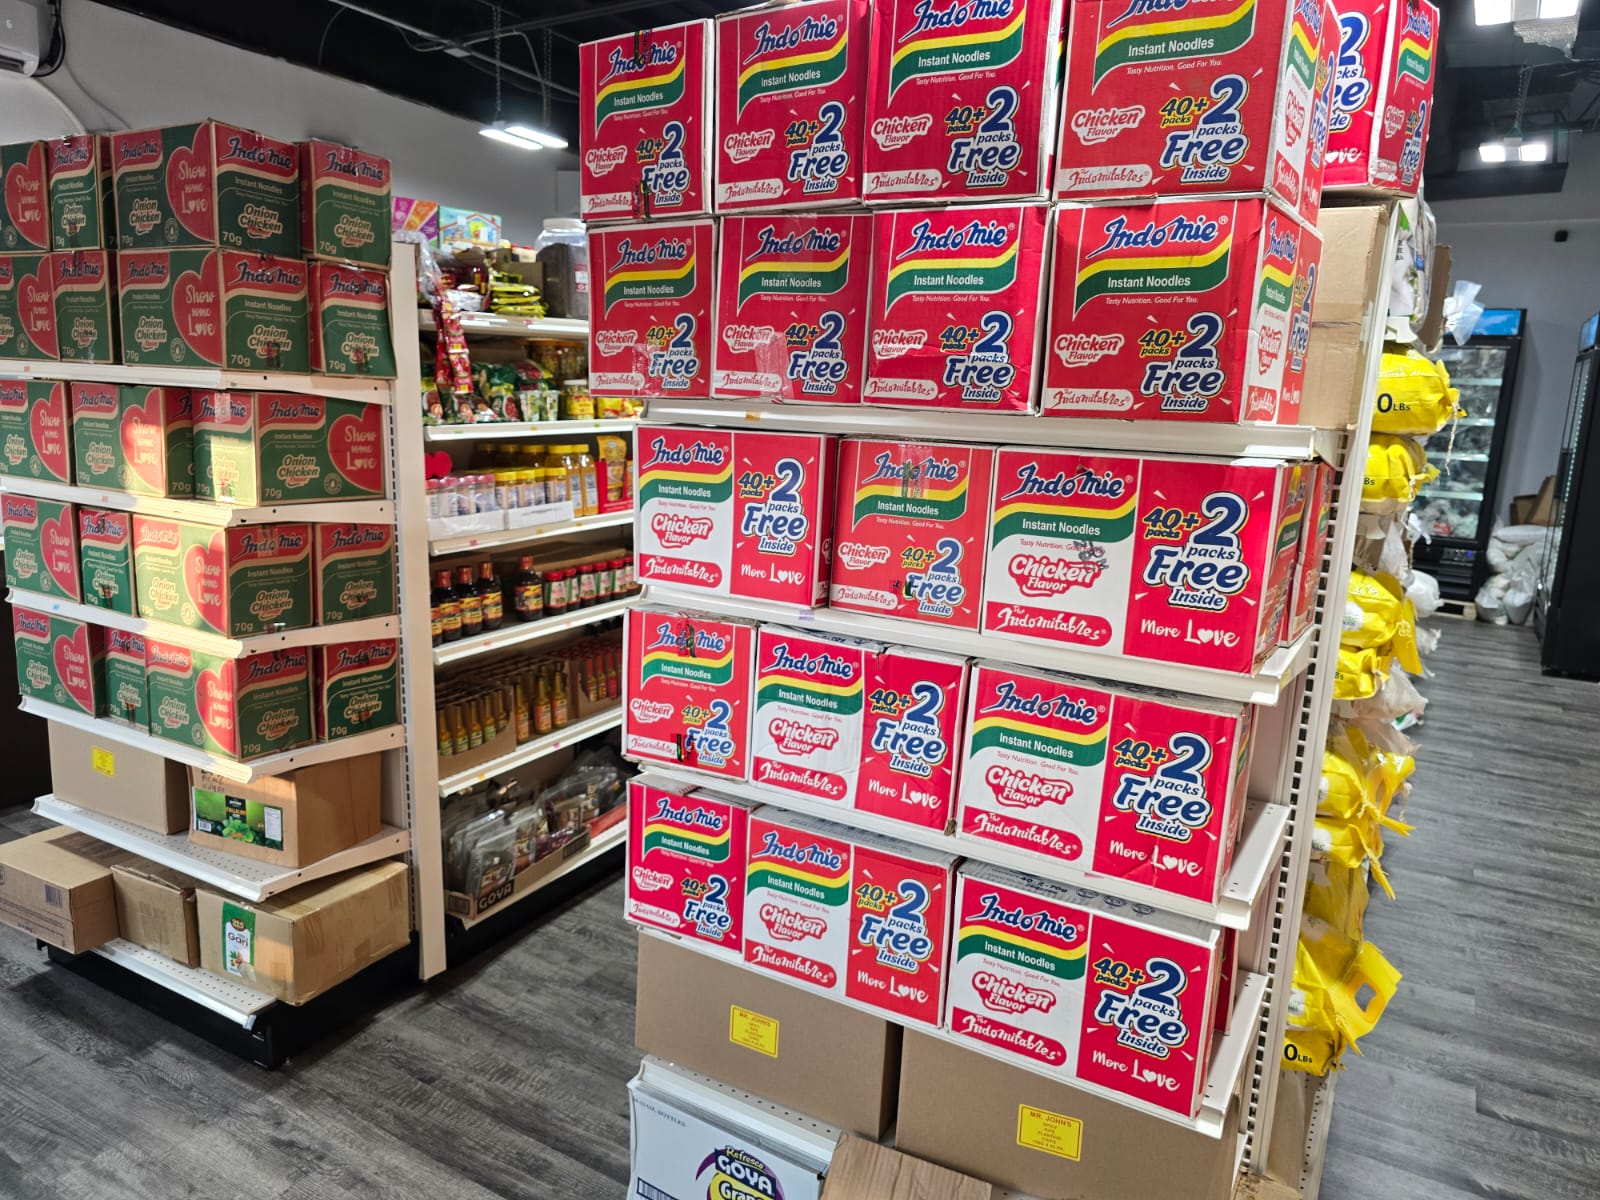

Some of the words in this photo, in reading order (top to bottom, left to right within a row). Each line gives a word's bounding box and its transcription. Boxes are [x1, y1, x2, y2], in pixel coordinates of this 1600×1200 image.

[1129, 44, 1165, 56] Instant
[1168, 38, 1214, 51] Noodles
[918, 57, 949, 67] Instant
[952, 51, 990, 63] Noodles
[761, 75, 787, 87] Instant
[789, 70, 820, 82] Noodles
[614, 95, 638, 105] Instant
[639, 92, 663, 102] Noodles
[1203, 77, 1244, 124] 2
[816, 103, 844, 143] 2
[874, 119, 927, 134] Chicken
[1075, 113, 1139, 128] Chicken
[1162, 115, 1192, 125] packs
[1087, 128, 1118, 137] Flavor
[726, 134, 771, 148] Chicken
[950, 144, 1016, 169] Free
[1163, 134, 1244, 164] Free
[179, 162, 207, 180] Show
[789, 155, 846, 178] Free
[1183, 168, 1227, 179] Inside
[804, 179, 835, 190] Inside
[969, 172, 1004, 183] Inside
[655, 193, 681, 203] Inside
[133, 199, 157, 213] Onion
[243, 204, 278, 220] Onion
[240, 216, 282, 232] Chicken
[339, 216, 370, 231] Onion
[222, 231, 242, 245] 70g
[335, 226, 374, 241] Chicken
[320, 241, 337, 254] 70g
[761, 278, 788, 287] Instant
[790, 278, 821, 287] Noodles
[914, 276, 944, 285] Instant
[947, 276, 984, 285] Noodles
[1108, 277, 1144, 288] Instant
[1147, 276, 1190, 287] Noodles
[186, 285, 215, 302] Show
[624, 286, 647, 295] Instant
[648, 286, 674, 294] Noodles
[136, 328, 167, 341] Chicken
[254, 326, 287, 340] Onion
[598, 333, 634, 343] Chicken
[873, 332, 924, 345] Chicken
[1178, 315, 1219, 357] 2
[1055, 337, 1118, 350] Chicken
[231, 355, 250, 366] 70g
[1069, 352, 1098, 361] Flavor
[1176, 359, 1215, 369] packs
[329, 360, 345, 371] 70g
[790, 354, 847, 377] Free
[946, 358, 1010, 383] Free
[1144, 365, 1220, 392] Free
[964, 387, 999, 398] Inside
[345, 426, 376, 442] Show
[282, 456, 316, 468] Onion
[278, 466, 320, 479] Chicken
[172, 482, 191, 492] 70g
[658, 485, 682, 495] Instant
[683, 487, 711, 498] Noodles
[878, 501, 903, 512] Instant
[906, 503, 939, 515] Noodles
[653, 515, 708, 535] Chicken
[744, 507, 805, 537] Free
[1022, 518, 1056, 531] Instant
[1059, 521, 1100, 535] Noodles
[1193, 497, 1243, 546] 2
[665, 533, 691, 545] Flavor
[760, 539, 794, 552] Inside
[840, 545, 887, 560] Chicken
[1187, 547, 1235, 560] packs
[741, 564, 766, 579] More
[1012, 556, 1093, 580] Chicken
[1146, 549, 1245, 588] Free
[1028, 578, 1066, 592] Flavor
[256, 590, 289, 604] Onion
[1171, 590, 1224, 607] Inside
[251, 600, 292, 613] Chicken
[235, 622, 253, 631] 70g
[1141, 619, 1180, 637] More
[661, 664, 684, 676] Instant
[685, 668, 711, 679] Noodles
[262, 709, 295, 724] Onion
[258, 718, 297, 734] Chicken
[771, 720, 834, 745] Chicken
[783, 738, 812, 753] Flavor
[874, 721, 942, 760] Free
[1000, 733, 1031, 748] Instant
[1034, 740, 1074, 759] Noodles
[243, 744, 260, 754] 70g
[869, 779, 897, 797] More
[988, 767, 1068, 797] Chicken
[1004, 788, 1040, 805] Flavor
[1116, 777, 1208, 821] Free
[1139, 817, 1187, 837] Inside
[1110, 841, 1147, 861] More
[480, 883, 512, 909] GOYA
[762, 906, 823, 935] Chicken
[228, 932, 248, 946] Gari
[860, 916, 929, 954] Free
[985, 941, 1016, 958] Instant
[1017, 950, 1055, 971] Noodles
[858, 970, 885, 989] More
[1139, 962, 1181, 1005] 2
[975, 973, 1049, 1009] Chicken
[1119, 1033, 1166, 1055] Inside
[1092, 1051, 1127, 1071] More
[726, 1147, 764, 1169] Refresco
[718, 1155, 772, 1195] GOYA
